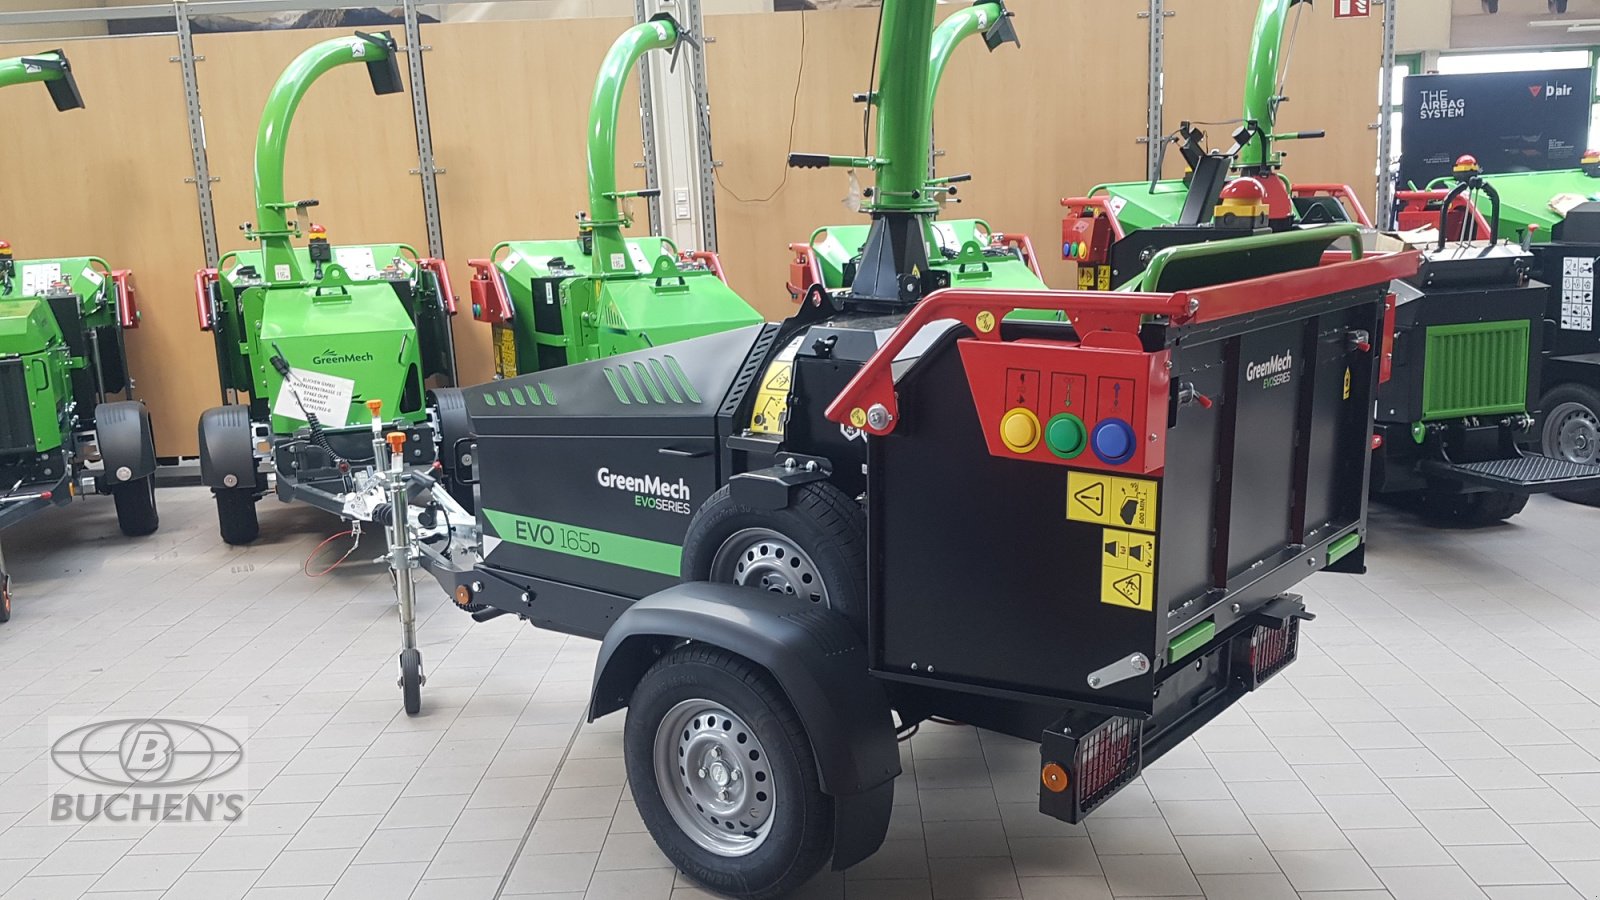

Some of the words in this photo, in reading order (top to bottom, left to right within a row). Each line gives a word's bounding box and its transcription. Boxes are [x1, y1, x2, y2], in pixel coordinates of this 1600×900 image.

[1420, 89, 1449, 102] THE
[1420, 99, 1465, 111] AIRBAG
[1420, 108, 1465, 120] SYSTEM
[313, 352, 373, 365] GreenMech
[1246, 349, 1292, 382] GreenMech
[1262, 371, 1291, 389] EVOSERIES
[597, 466, 691, 501] GreenMech
[634, 494, 691, 515] EVOSERIES
[515, 519, 554, 546] EVO
[560, 527, 600, 555] 165D
